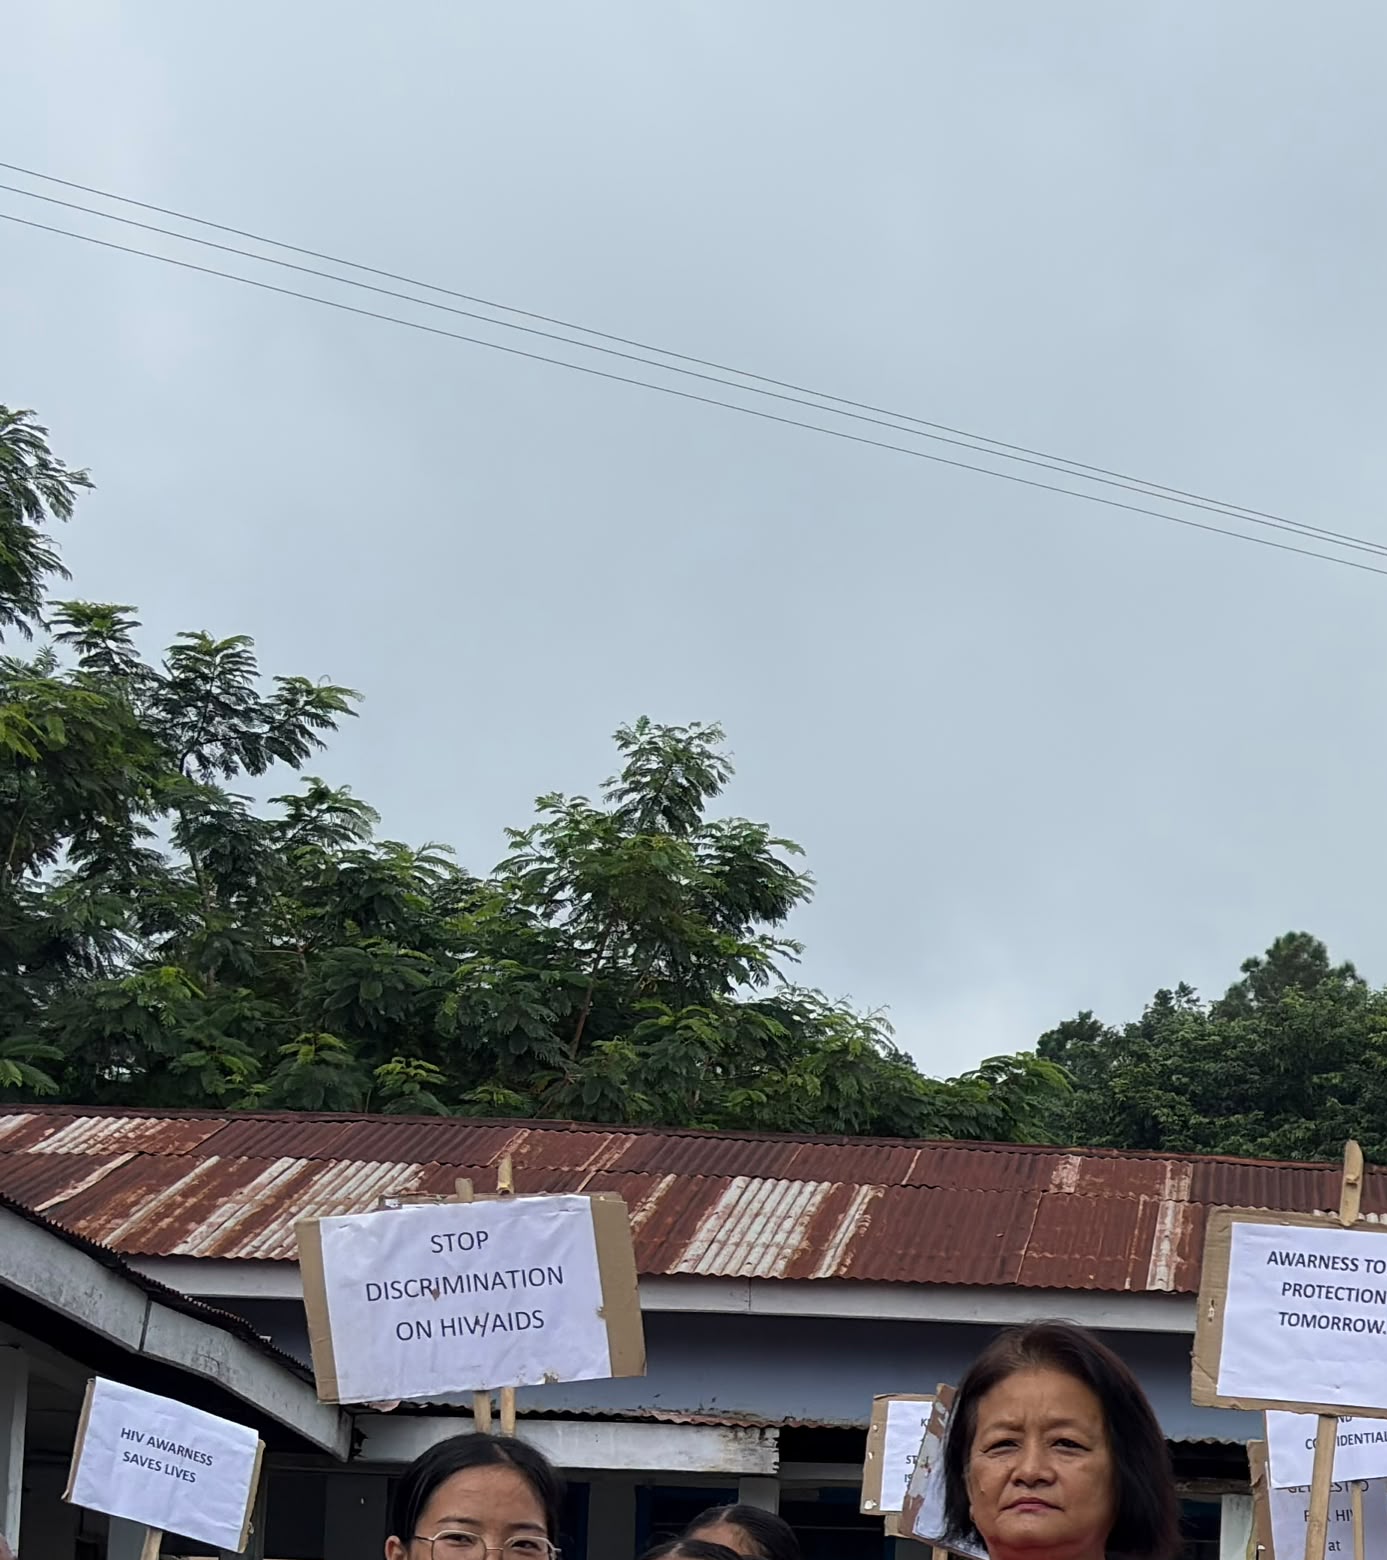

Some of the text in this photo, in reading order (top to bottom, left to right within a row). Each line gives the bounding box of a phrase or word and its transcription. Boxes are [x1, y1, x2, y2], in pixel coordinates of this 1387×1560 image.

[431, 1231, 488, 1253] STOP
[1267, 1251, 1359, 1272] AWARNESS
[366, 1266, 563, 1301] DISCRIMINATION
[1281, 1282, 1387, 1305] PROTECTION
[396, 1310, 544, 1341] ON HIV/AIDS
[1279, 1311, 1387, 1334] TOMORROW.
[121, 1428, 213, 1466] HIV AWARNESS
[122, 1452, 196, 1483] SAVES LIVES
[1328, 1541, 1341, 1551] at
